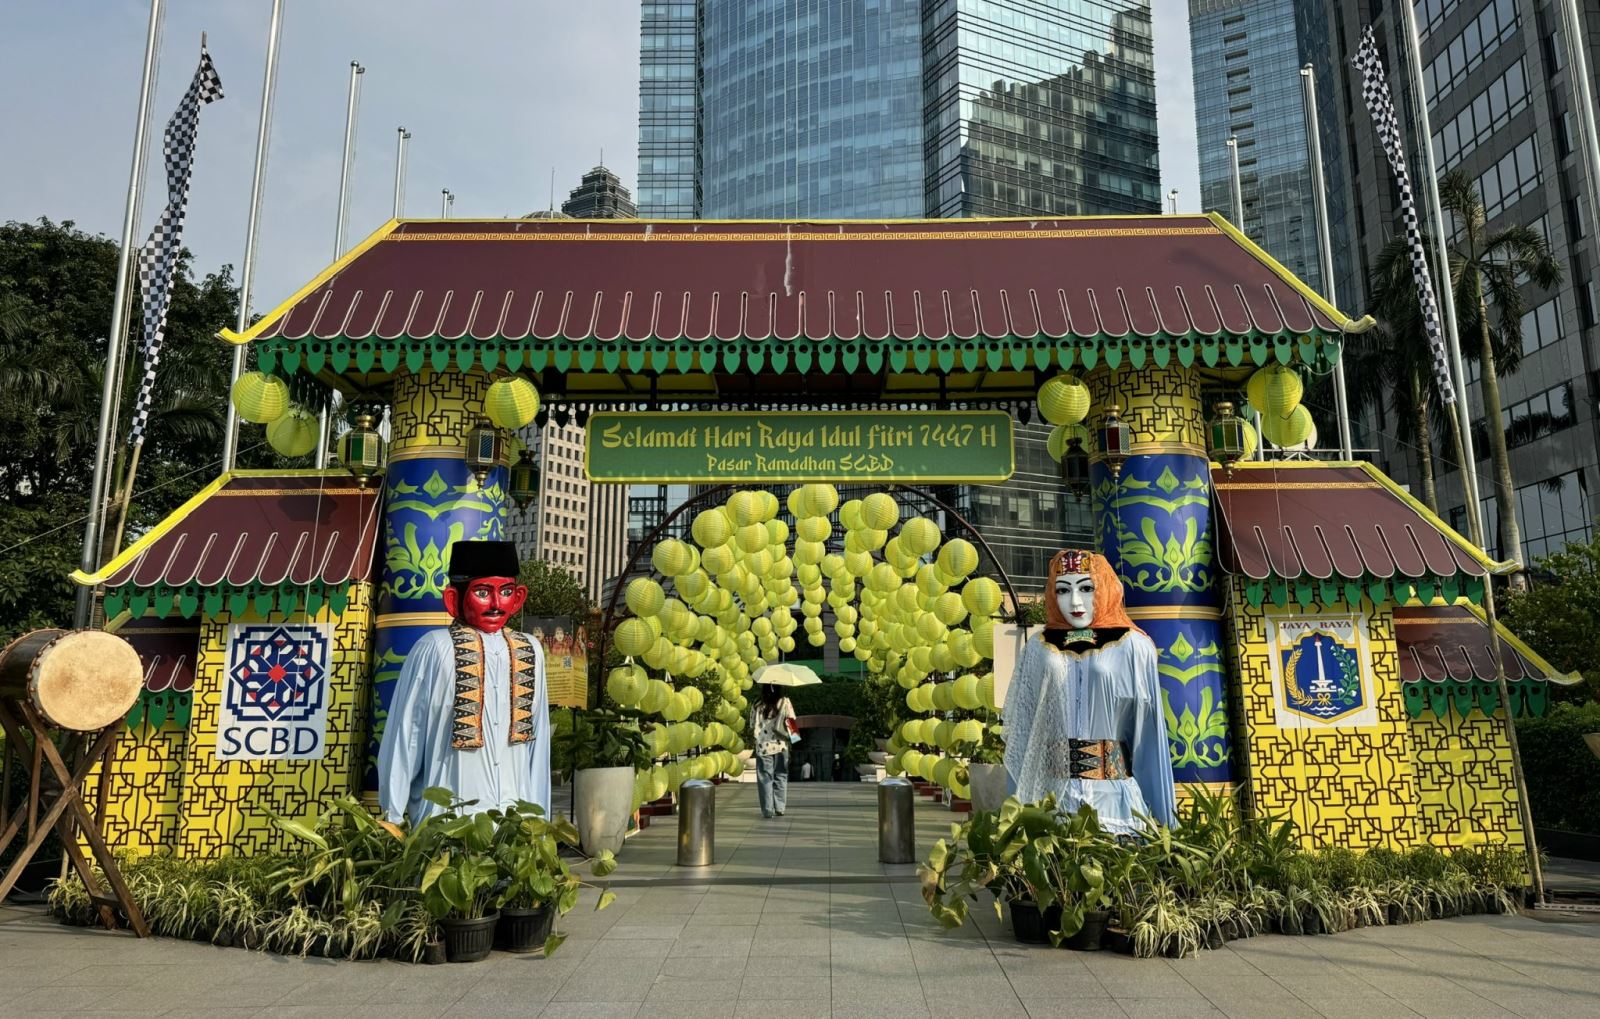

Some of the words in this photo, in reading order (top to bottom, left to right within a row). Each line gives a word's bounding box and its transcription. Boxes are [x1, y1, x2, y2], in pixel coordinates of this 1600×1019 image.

[602, 421, 698, 448] Selamat
[705, 426, 751, 448] Hari
[757, 420, 814, 453] Raya
[821, 425, 861, 447] Idul
[981, 424, 996, 447] H
[707, 454, 752, 472] Pasar
[755, 453, 836, 472] Ramadhan
[840, 454, 894, 472] SCBD
[1280, 621, 1311, 630] JAYA
[1320, 621, 1352, 629] RAYA
[222, 727, 318, 756] SCBD
